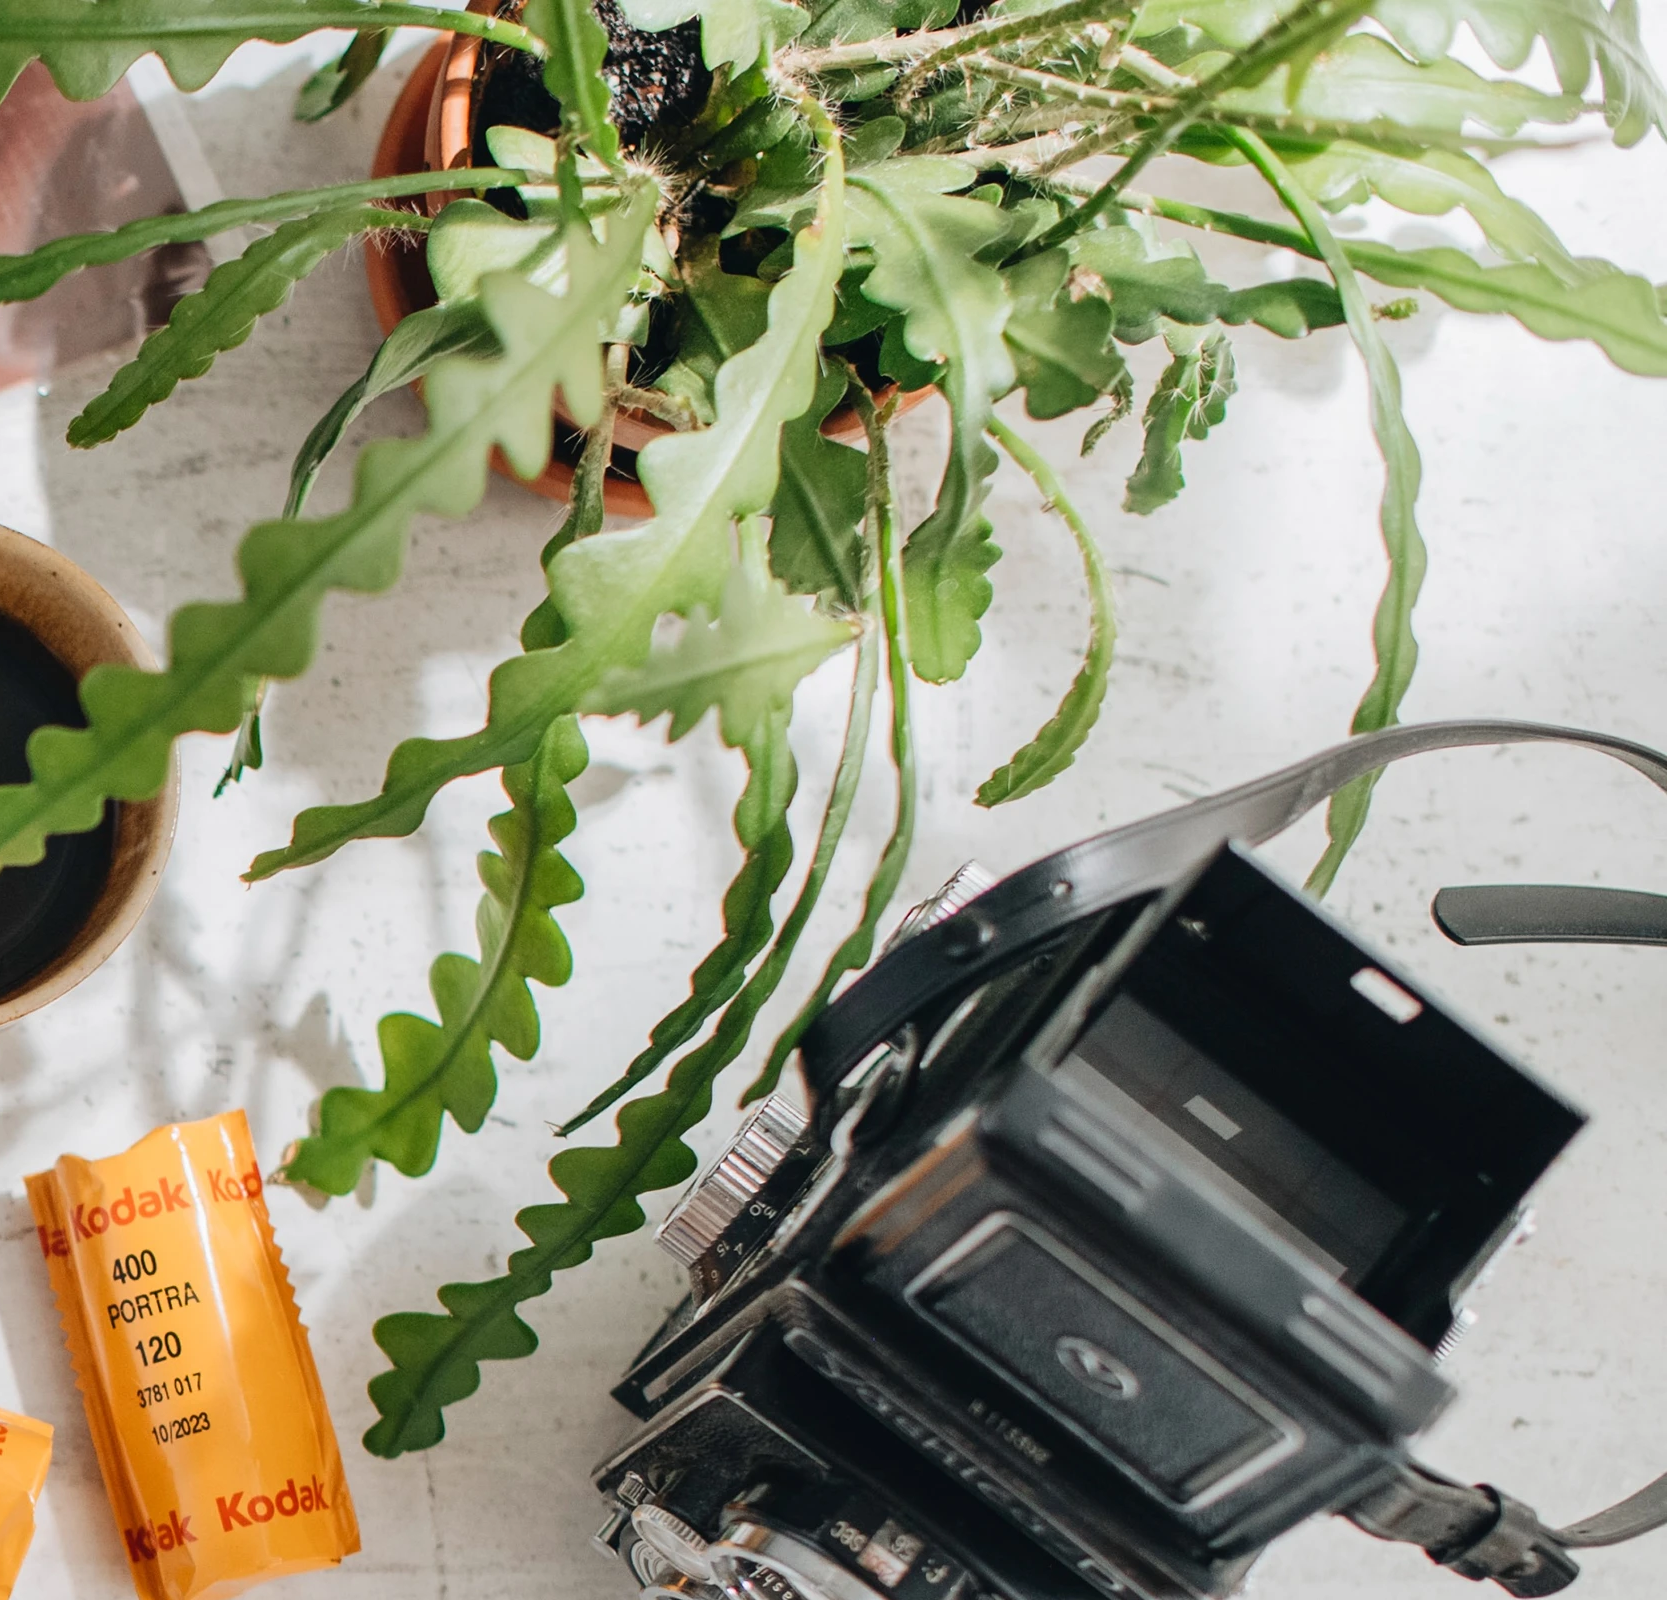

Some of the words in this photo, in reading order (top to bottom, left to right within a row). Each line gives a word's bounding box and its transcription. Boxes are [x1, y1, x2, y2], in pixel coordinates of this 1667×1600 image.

[69, 1176, 191, 1244] Kodak
[113, 1249, 158, 1284] 400
[107, 1282, 201, 1330] PORTRA
[135, 1331, 182, 1367] 120
[136, 1382, 170, 1409] 3781
[174, 1372, 202, 1396] 017
[152, 1412, 211, 1445] 10/2023
[215, 1474, 329, 1533] Kodak
